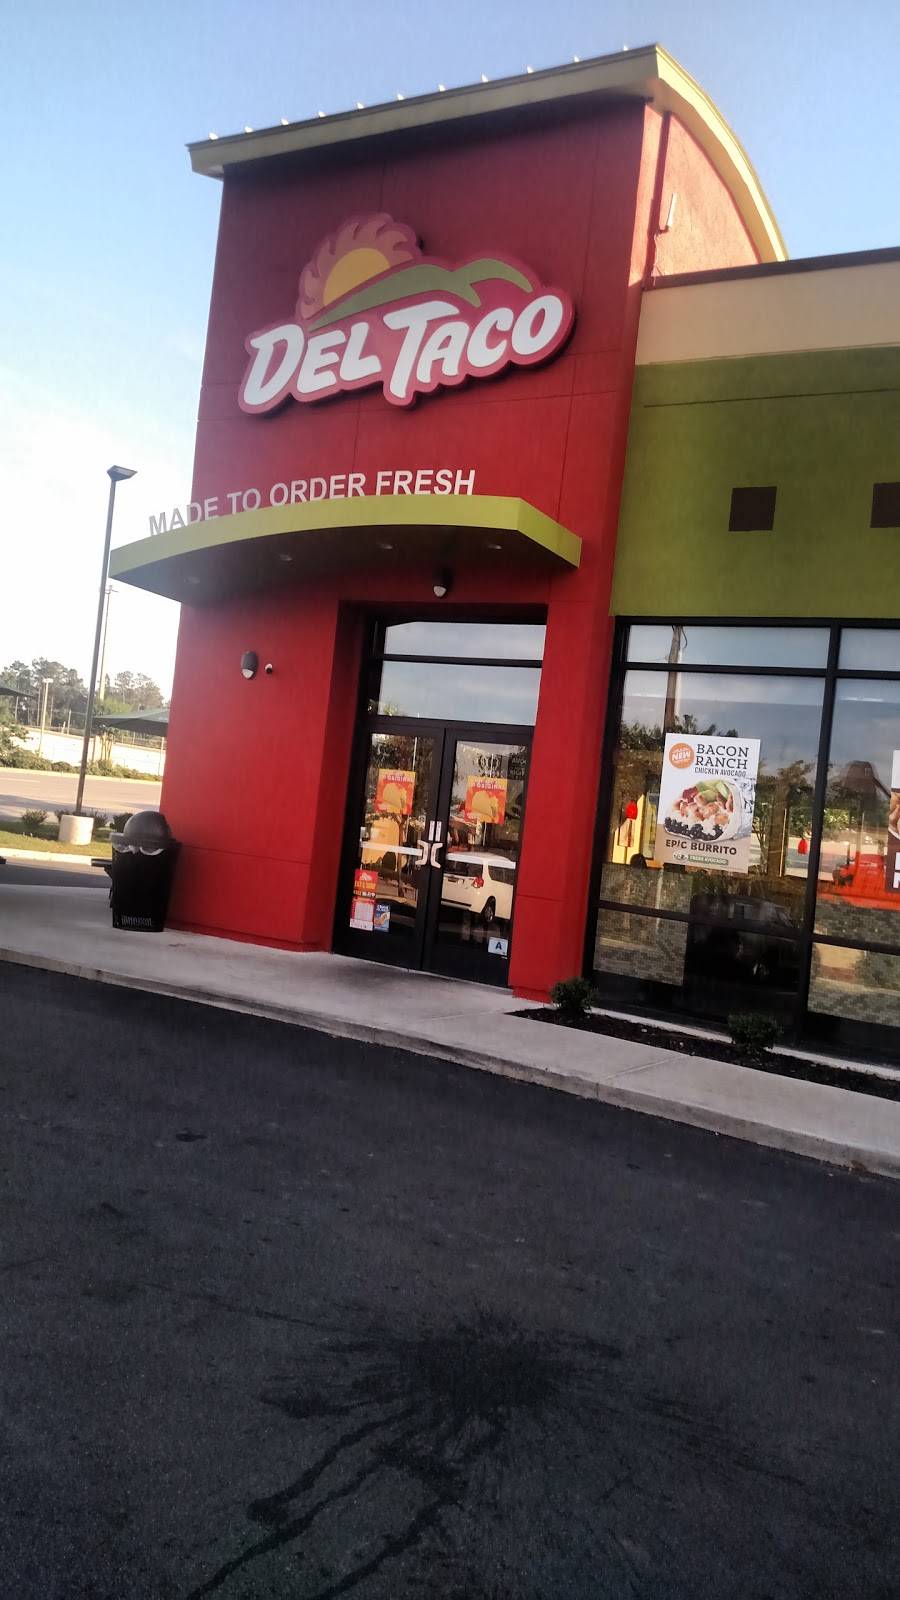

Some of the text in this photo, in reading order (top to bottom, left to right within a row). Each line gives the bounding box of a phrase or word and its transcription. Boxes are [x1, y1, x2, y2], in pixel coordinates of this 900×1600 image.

[243, 295, 563, 405] DEL TACO
[149, 469, 475, 536] MADE TO ORDER FRESH
[672, 750, 691, 761] NEW
[696, 744, 749, 758] BACON
[695, 756, 748, 769] RANCH
[695, 767, 746, 778] CHICKEN AVOCADO
[691, 842, 737, 855] BURRITO
[495, 942, 502, 950] A
